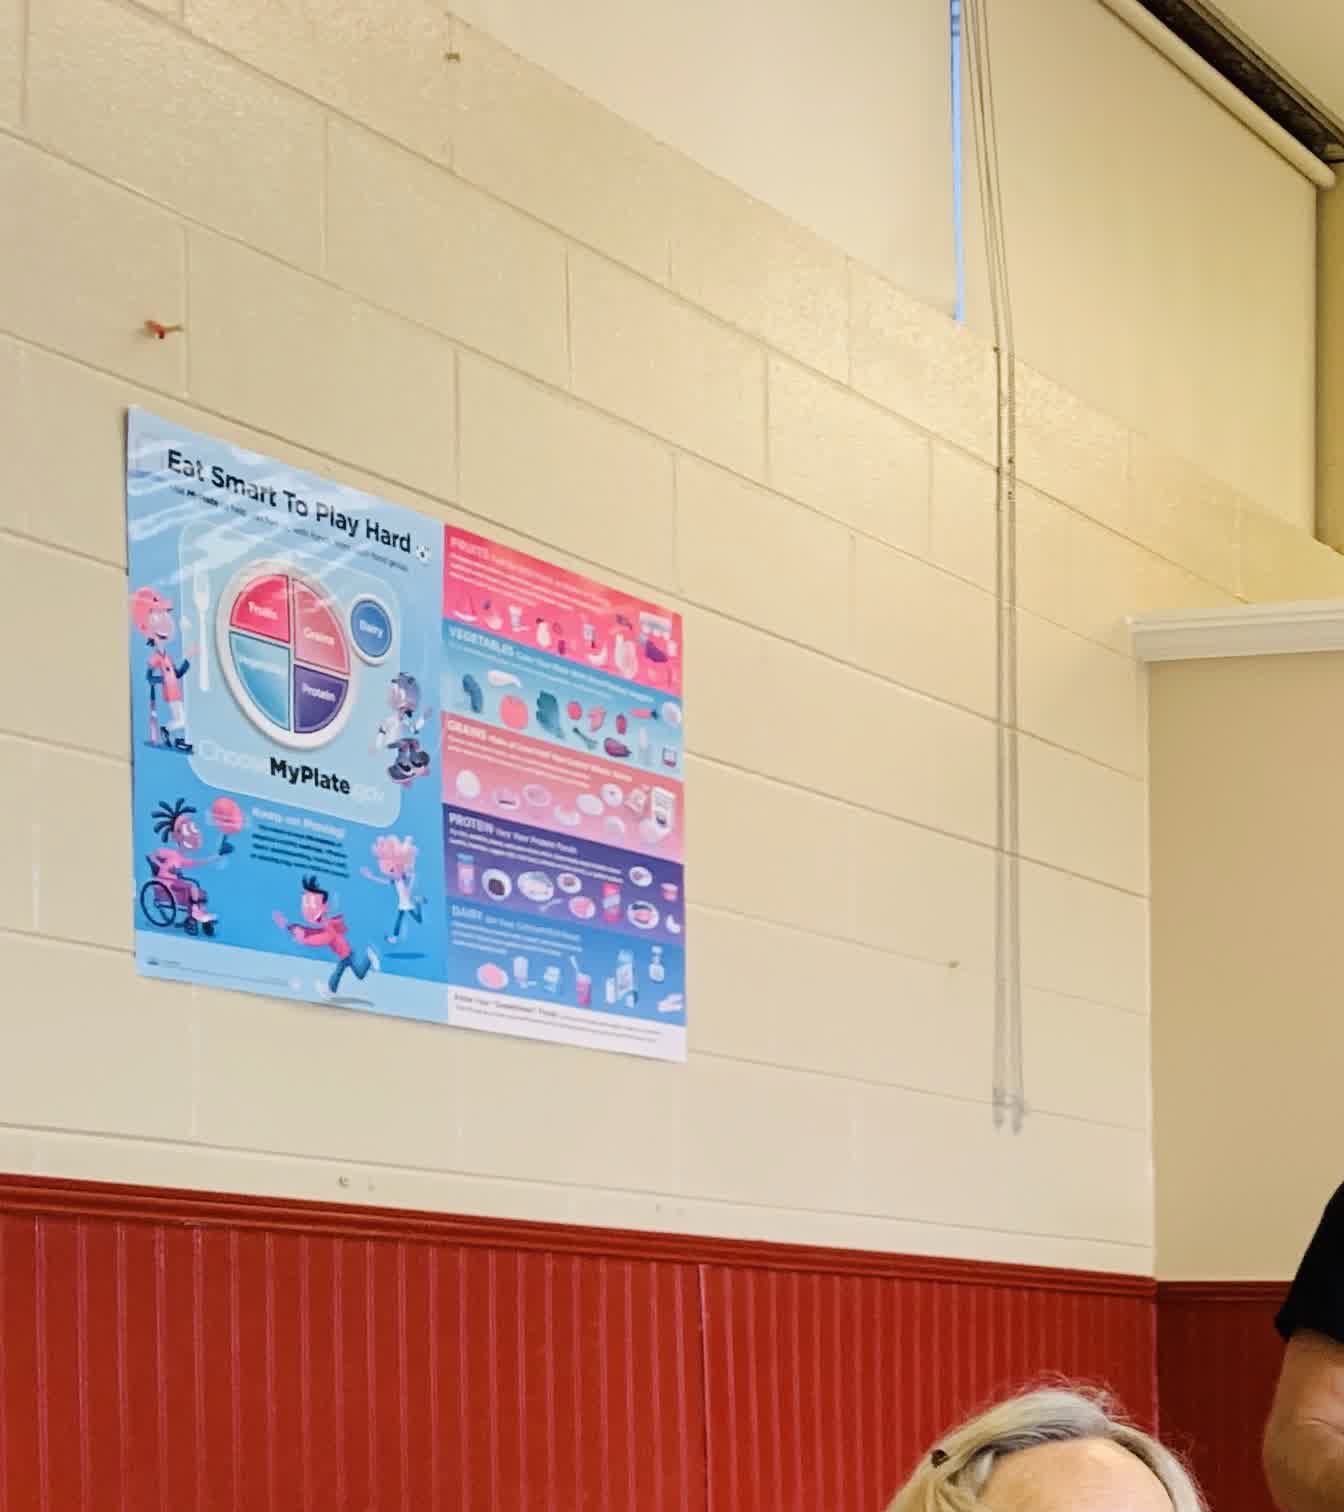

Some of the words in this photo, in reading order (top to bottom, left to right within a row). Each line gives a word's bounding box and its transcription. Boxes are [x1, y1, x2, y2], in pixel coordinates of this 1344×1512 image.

[167, 449, 204, 482] Eat
[211, 466, 277, 508] Smart
[283, 490, 309, 517] To
[315, 502, 359, 538] Play
[365, 518, 411, 553] Hard
[269, 756, 351, 795] MyPlate
